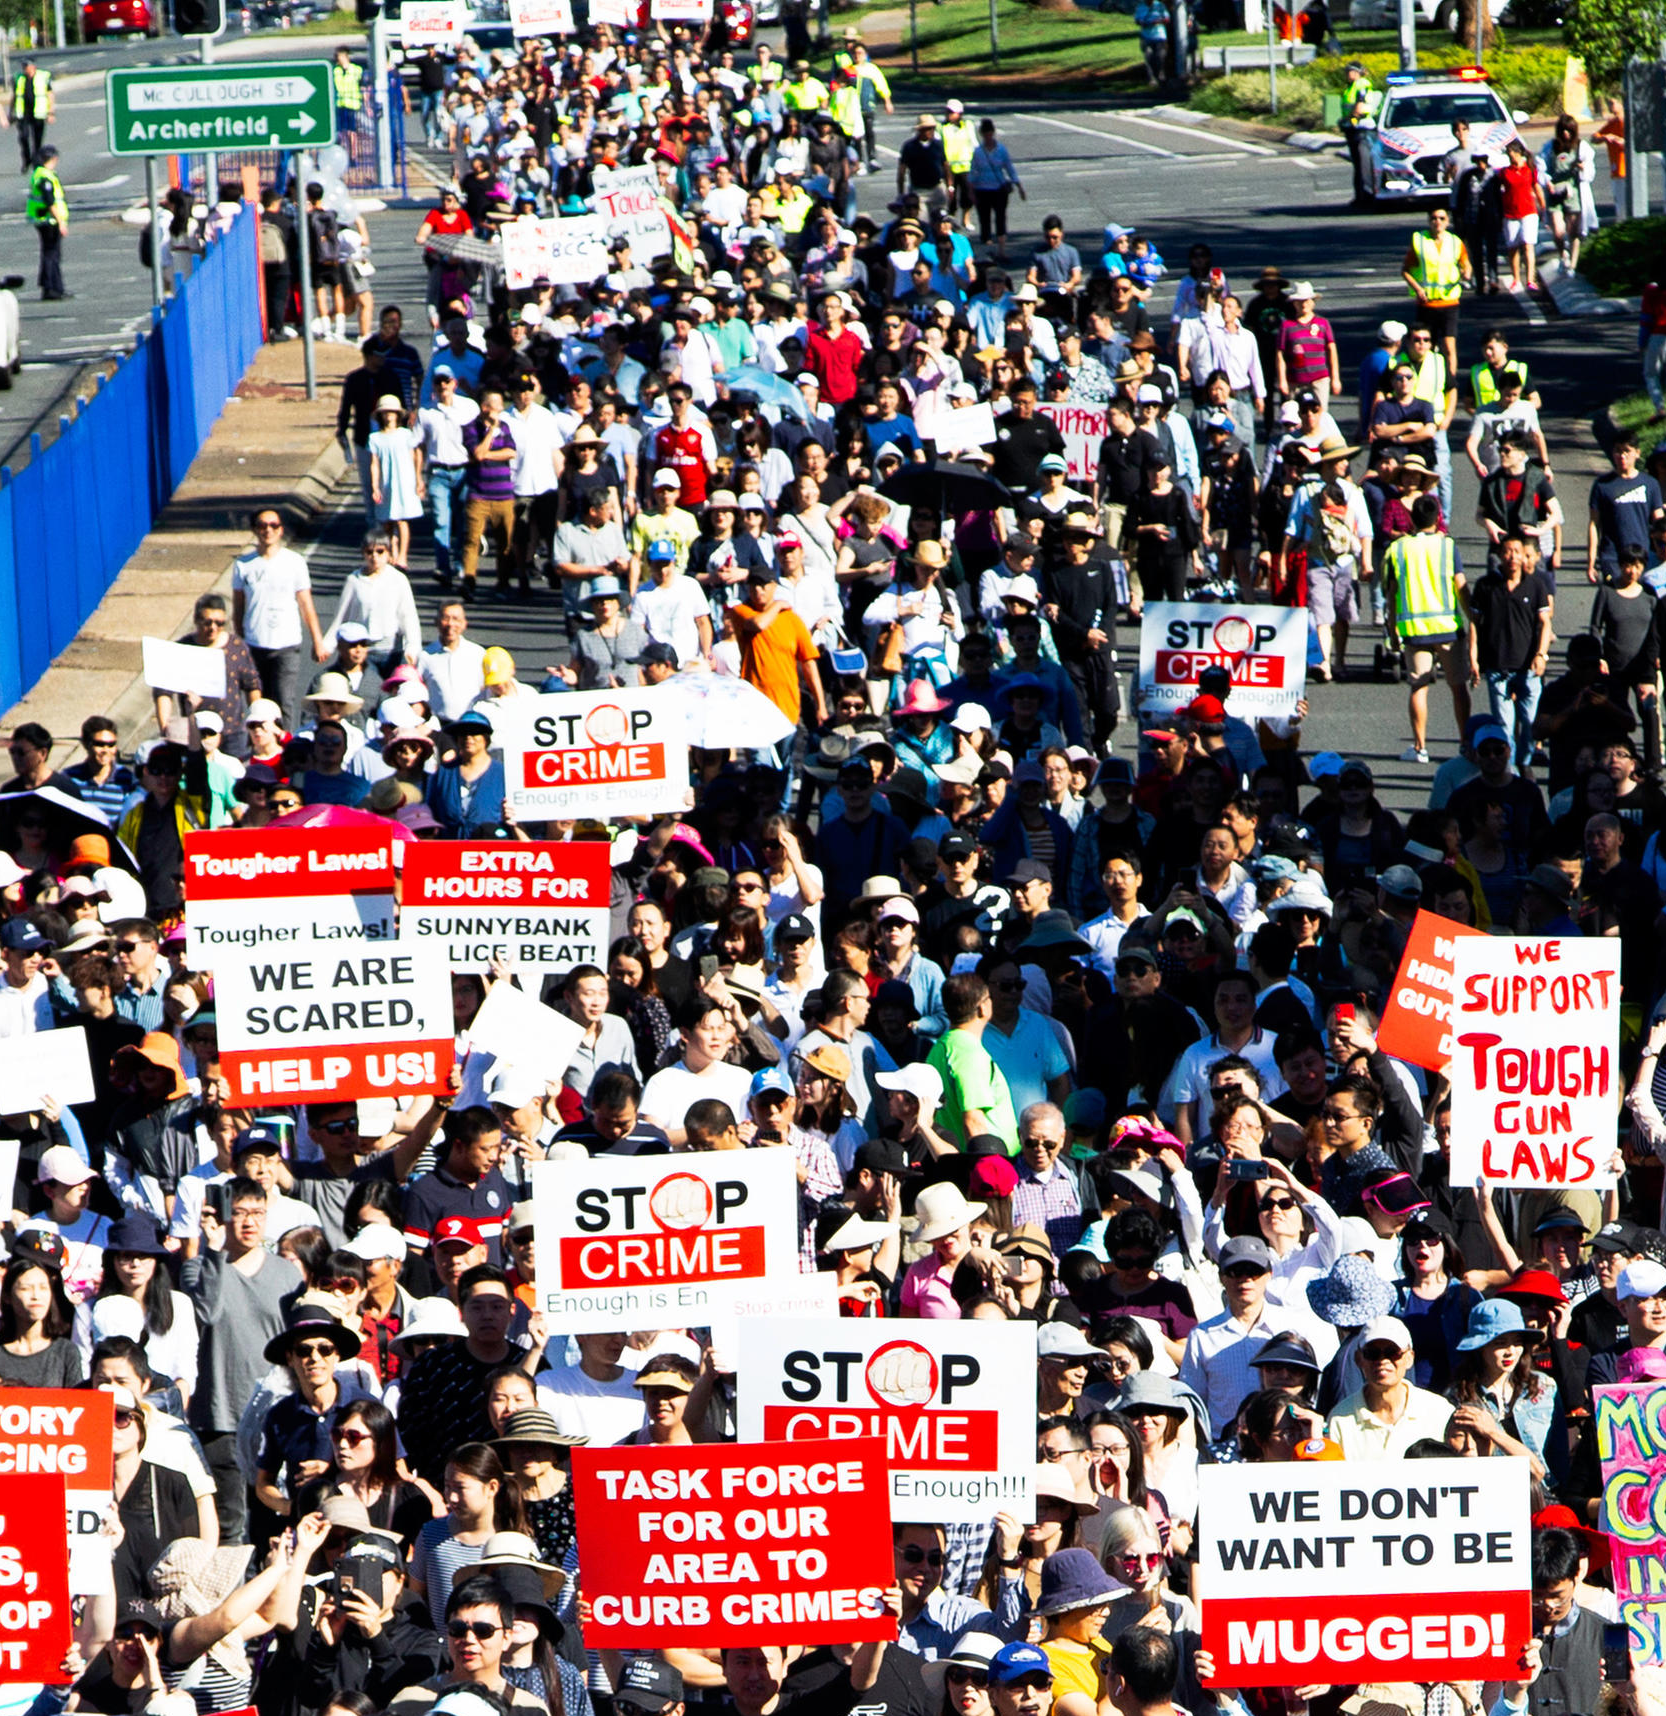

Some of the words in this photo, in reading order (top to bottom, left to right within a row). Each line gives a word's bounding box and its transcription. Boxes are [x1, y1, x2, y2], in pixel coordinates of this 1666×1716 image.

[173, 83, 263, 103] CULLOUGH
[275, 81, 295, 97] ST
[128, 114, 269, 141] Archerfield
[513, 789, 579, 807] Enough
[586, 787, 599, 801] is
[190, 853, 300, 880] Tougher
[308, 848, 387, 873] Laws!
[460, 851, 554, 873] EXTRA
[424, 877, 522, 898] HOURS
[532, 877, 589, 899] FOR
[194, 924, 300, 948] Tougher
[312, 917, 388, 940] Laws!
[416, 917, 591, 937] SUNNYBANK
[519, 944, 596, 963] BEAT!
[1515, 940, 1561, 965] WE
[249, 962, 314, 993] WE
[332, 956, 415, 988] ARE
[1461, 970, 1615, 1016] SUPPORT
[245, 998, 426, 1035] SCARED,
[240, 1056, 352, 1095] HELP
[365, 1051, 436, 1087] US!
[1457, 1032, 1610, 1098] TOUGH
[1494, 1100, 1572, 1134] GUN
[1482, 1136, 1595, 1183] LAWS
[579, 1233, 741, 1281] CR!ME
[547, 1293, 639, 1316] Enough
[649, 1291, 667, 1309] is
[596, 1468, 713, 1502] TASK
[721, 1461, 866, 1499] FORCE
[893, 1473, 1028, 1504] Enough!!!
[1249, 1490, 1321, 1524] WE
[1339, 1485, 1479, 1521] DON'T
[638, 1511, 726, 1543] FOR
[734, 1506, 831, 1540] OUR
[643, 1551, 762, 1585] AREA
[767, 1548, 828, 1582] TO
[1217, 1536, 1355, 1571] WANT
[1372, 1533, 1433, 1567] TO
[1454, 1531, 1514, 1565] BE
[591, 1594, 711, 1628] CURB
[721, 1587, 886, 1625] CRIMES
[1227, 1613, 1506, 1666] MUGGED!
